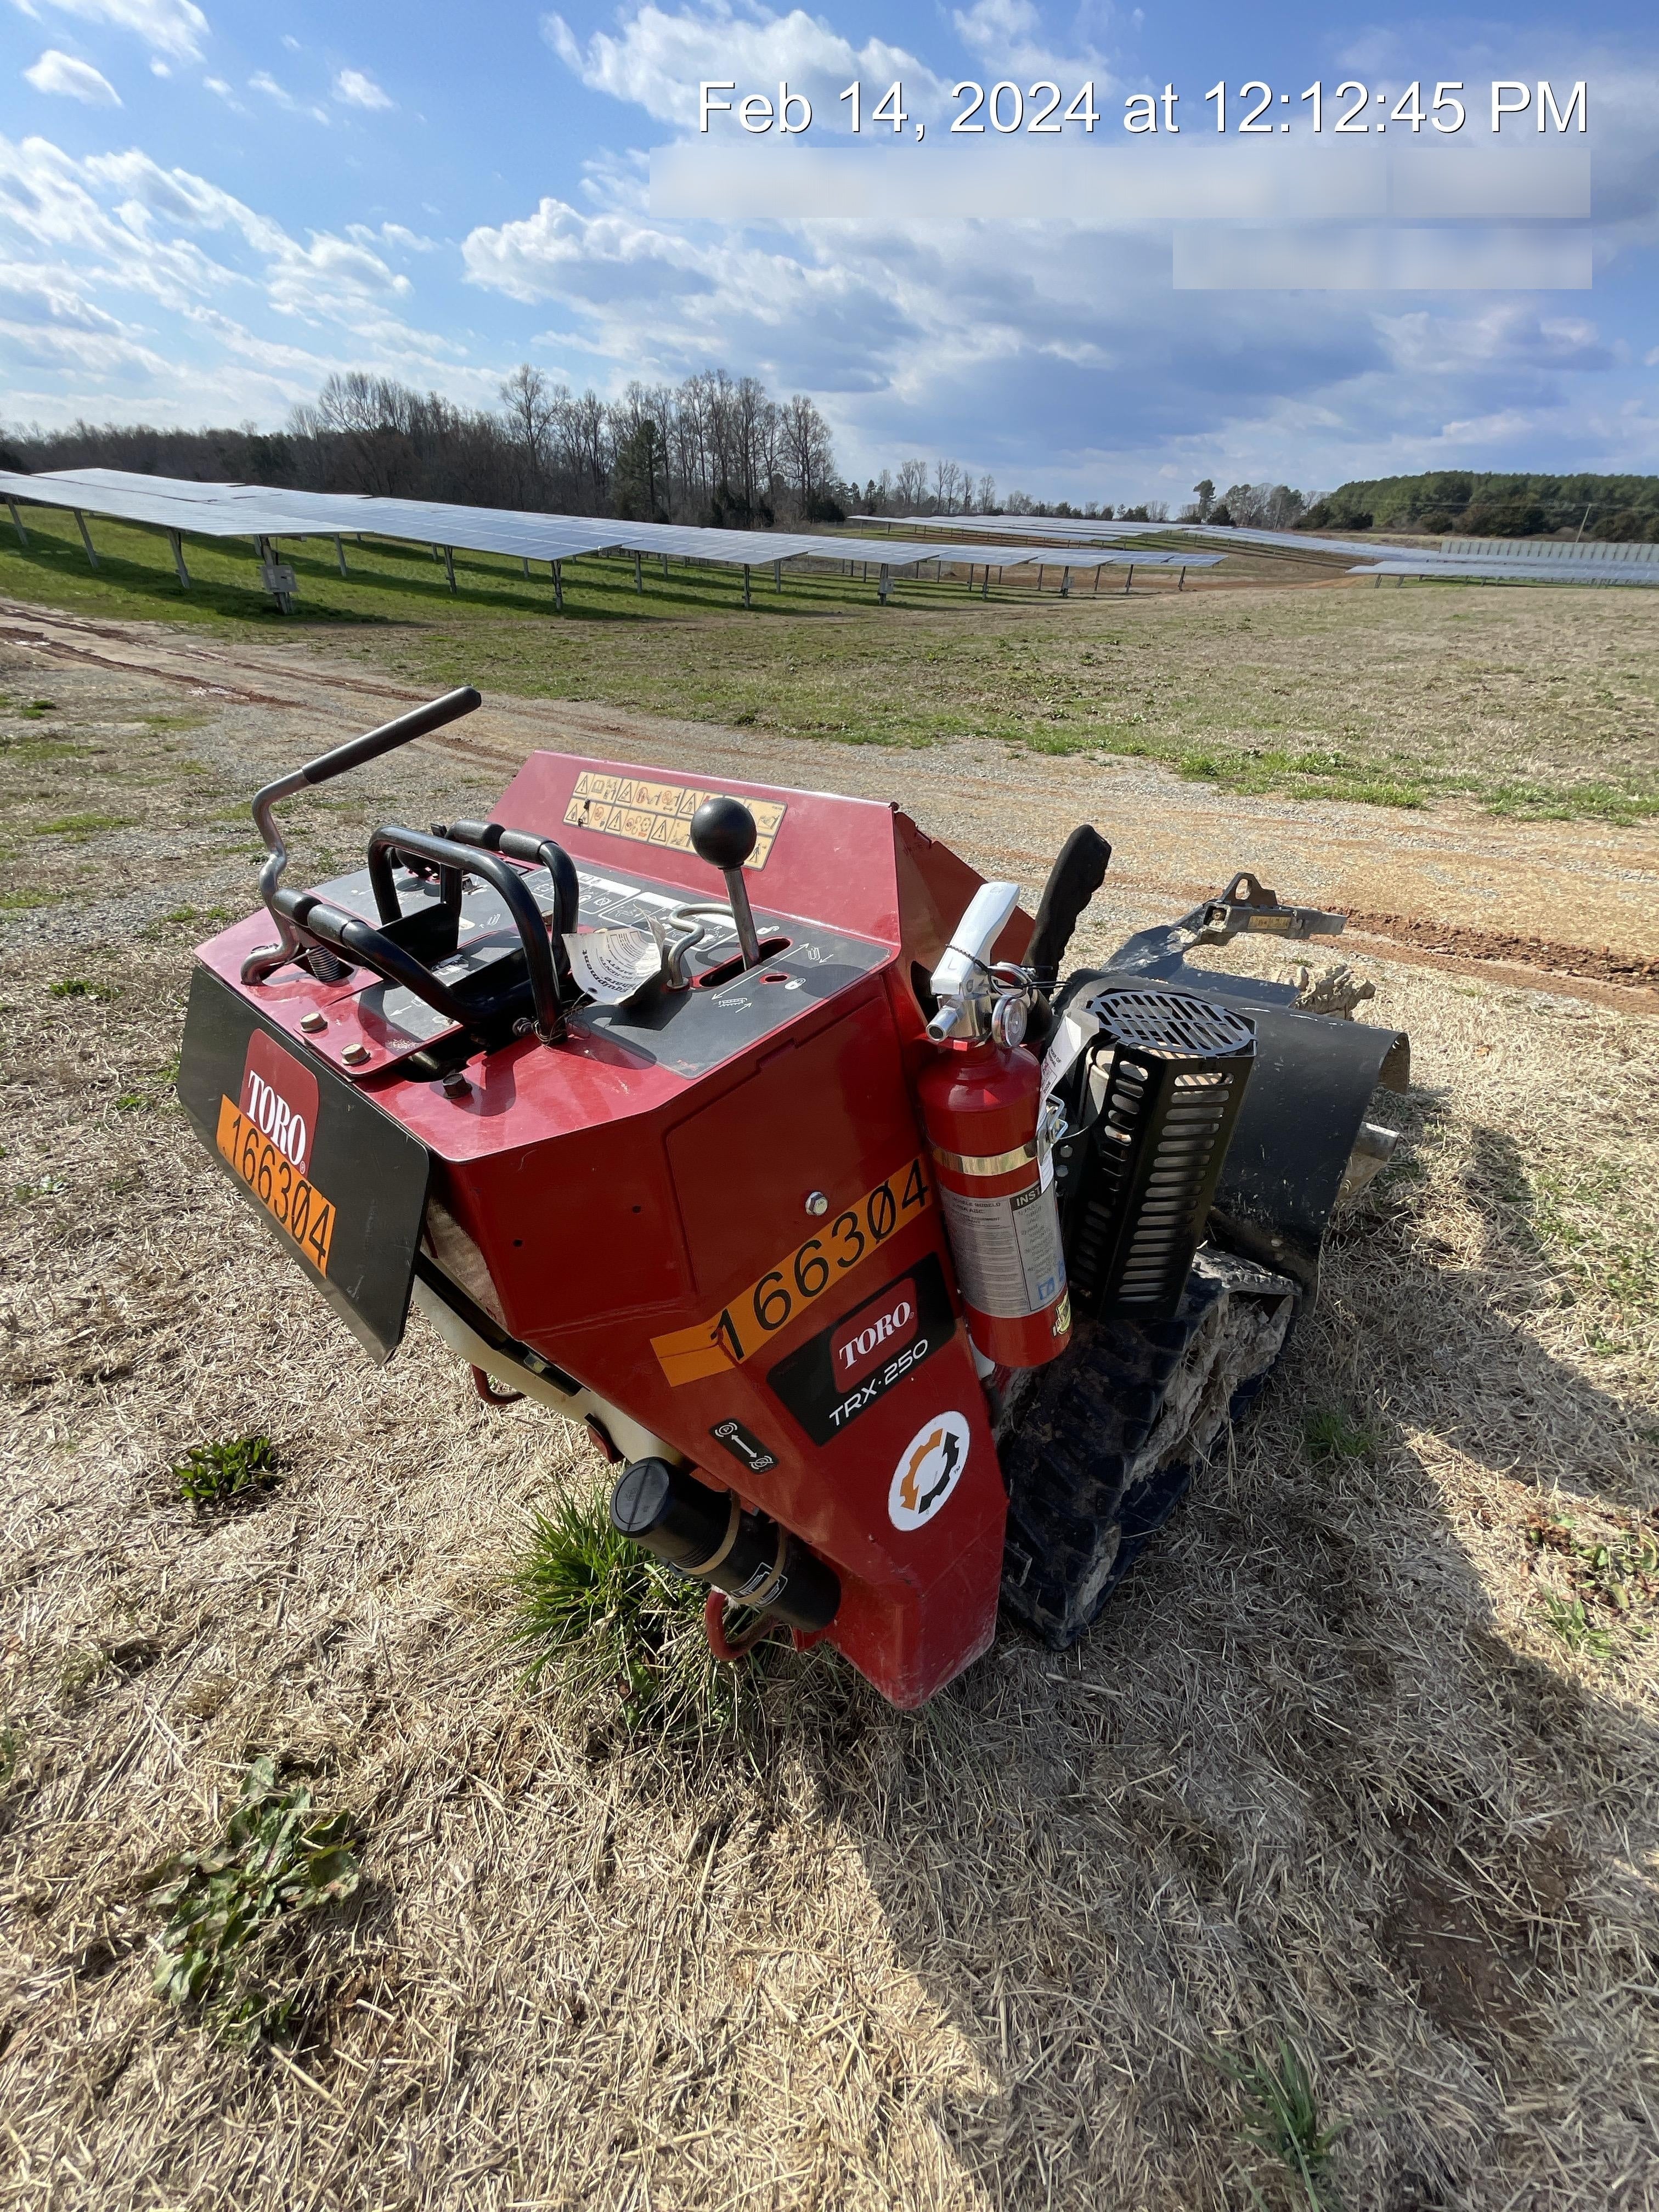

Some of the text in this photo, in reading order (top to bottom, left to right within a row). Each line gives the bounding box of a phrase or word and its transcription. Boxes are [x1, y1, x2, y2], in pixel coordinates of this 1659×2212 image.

[582, 949, 630, 992] Equipment
[247, 1070, 306, 1166] TORO
[233, 1114, 330, 1267] 166304
[711, 1158, 928, 1361] 166304
[839, 1302, 911, 1369] TORO
